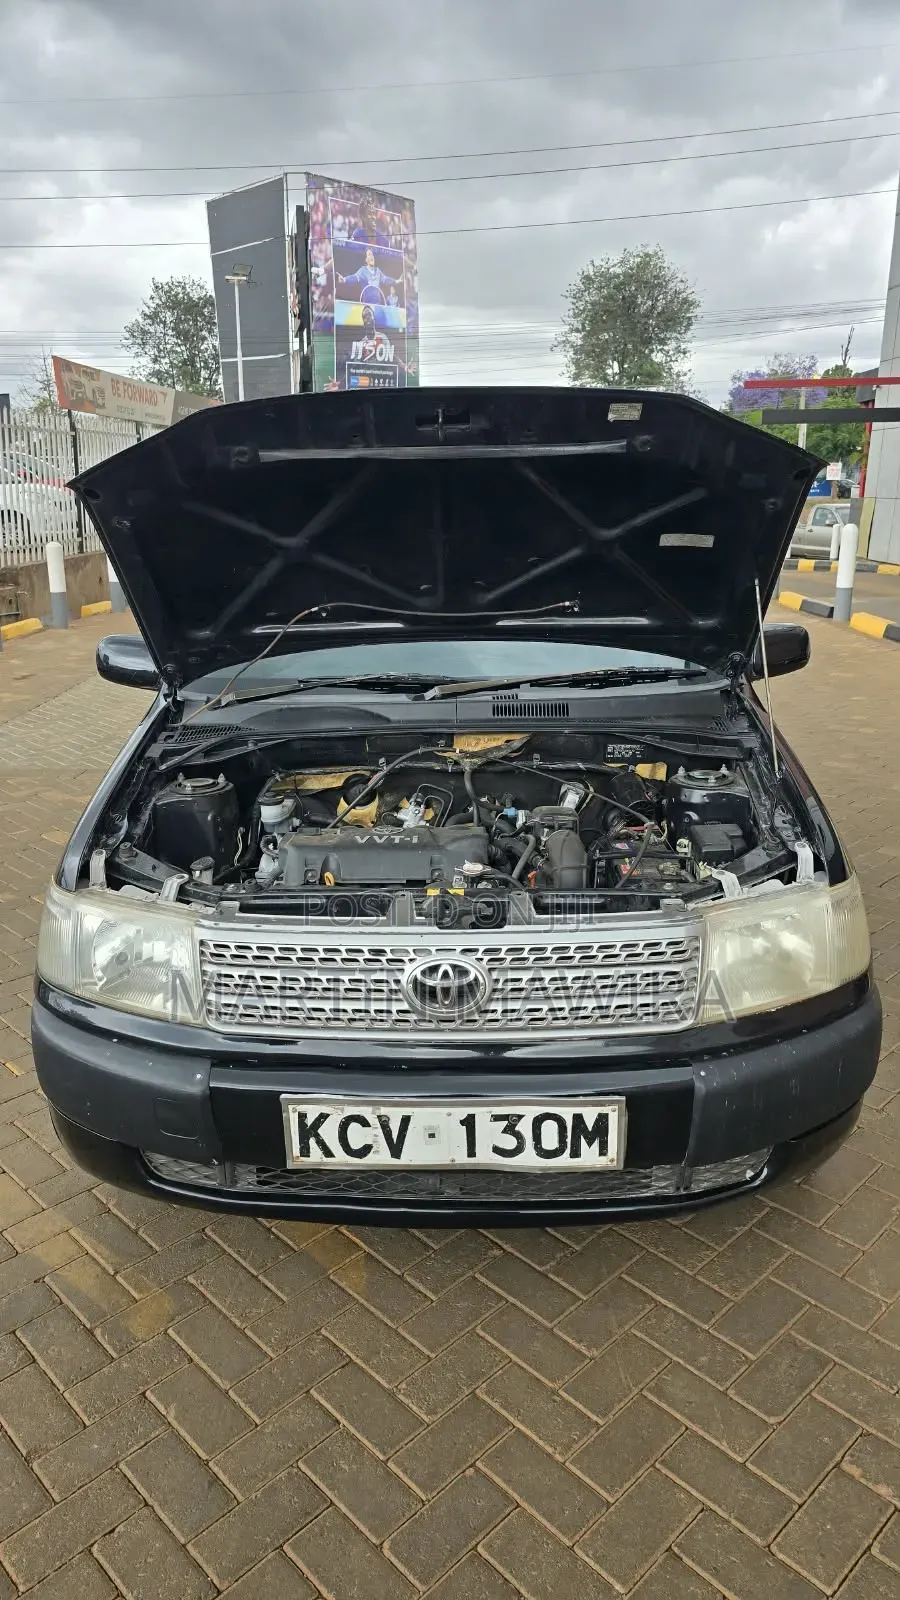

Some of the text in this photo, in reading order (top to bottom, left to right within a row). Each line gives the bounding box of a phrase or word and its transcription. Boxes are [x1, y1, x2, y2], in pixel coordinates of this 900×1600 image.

[376, 343, 395, 362] ON
[110, 378, 158, 408] BE FORWARD
[354, 834, 419, 844] VVT-i
[297, 1110, 609, 1160] KCV 130M
